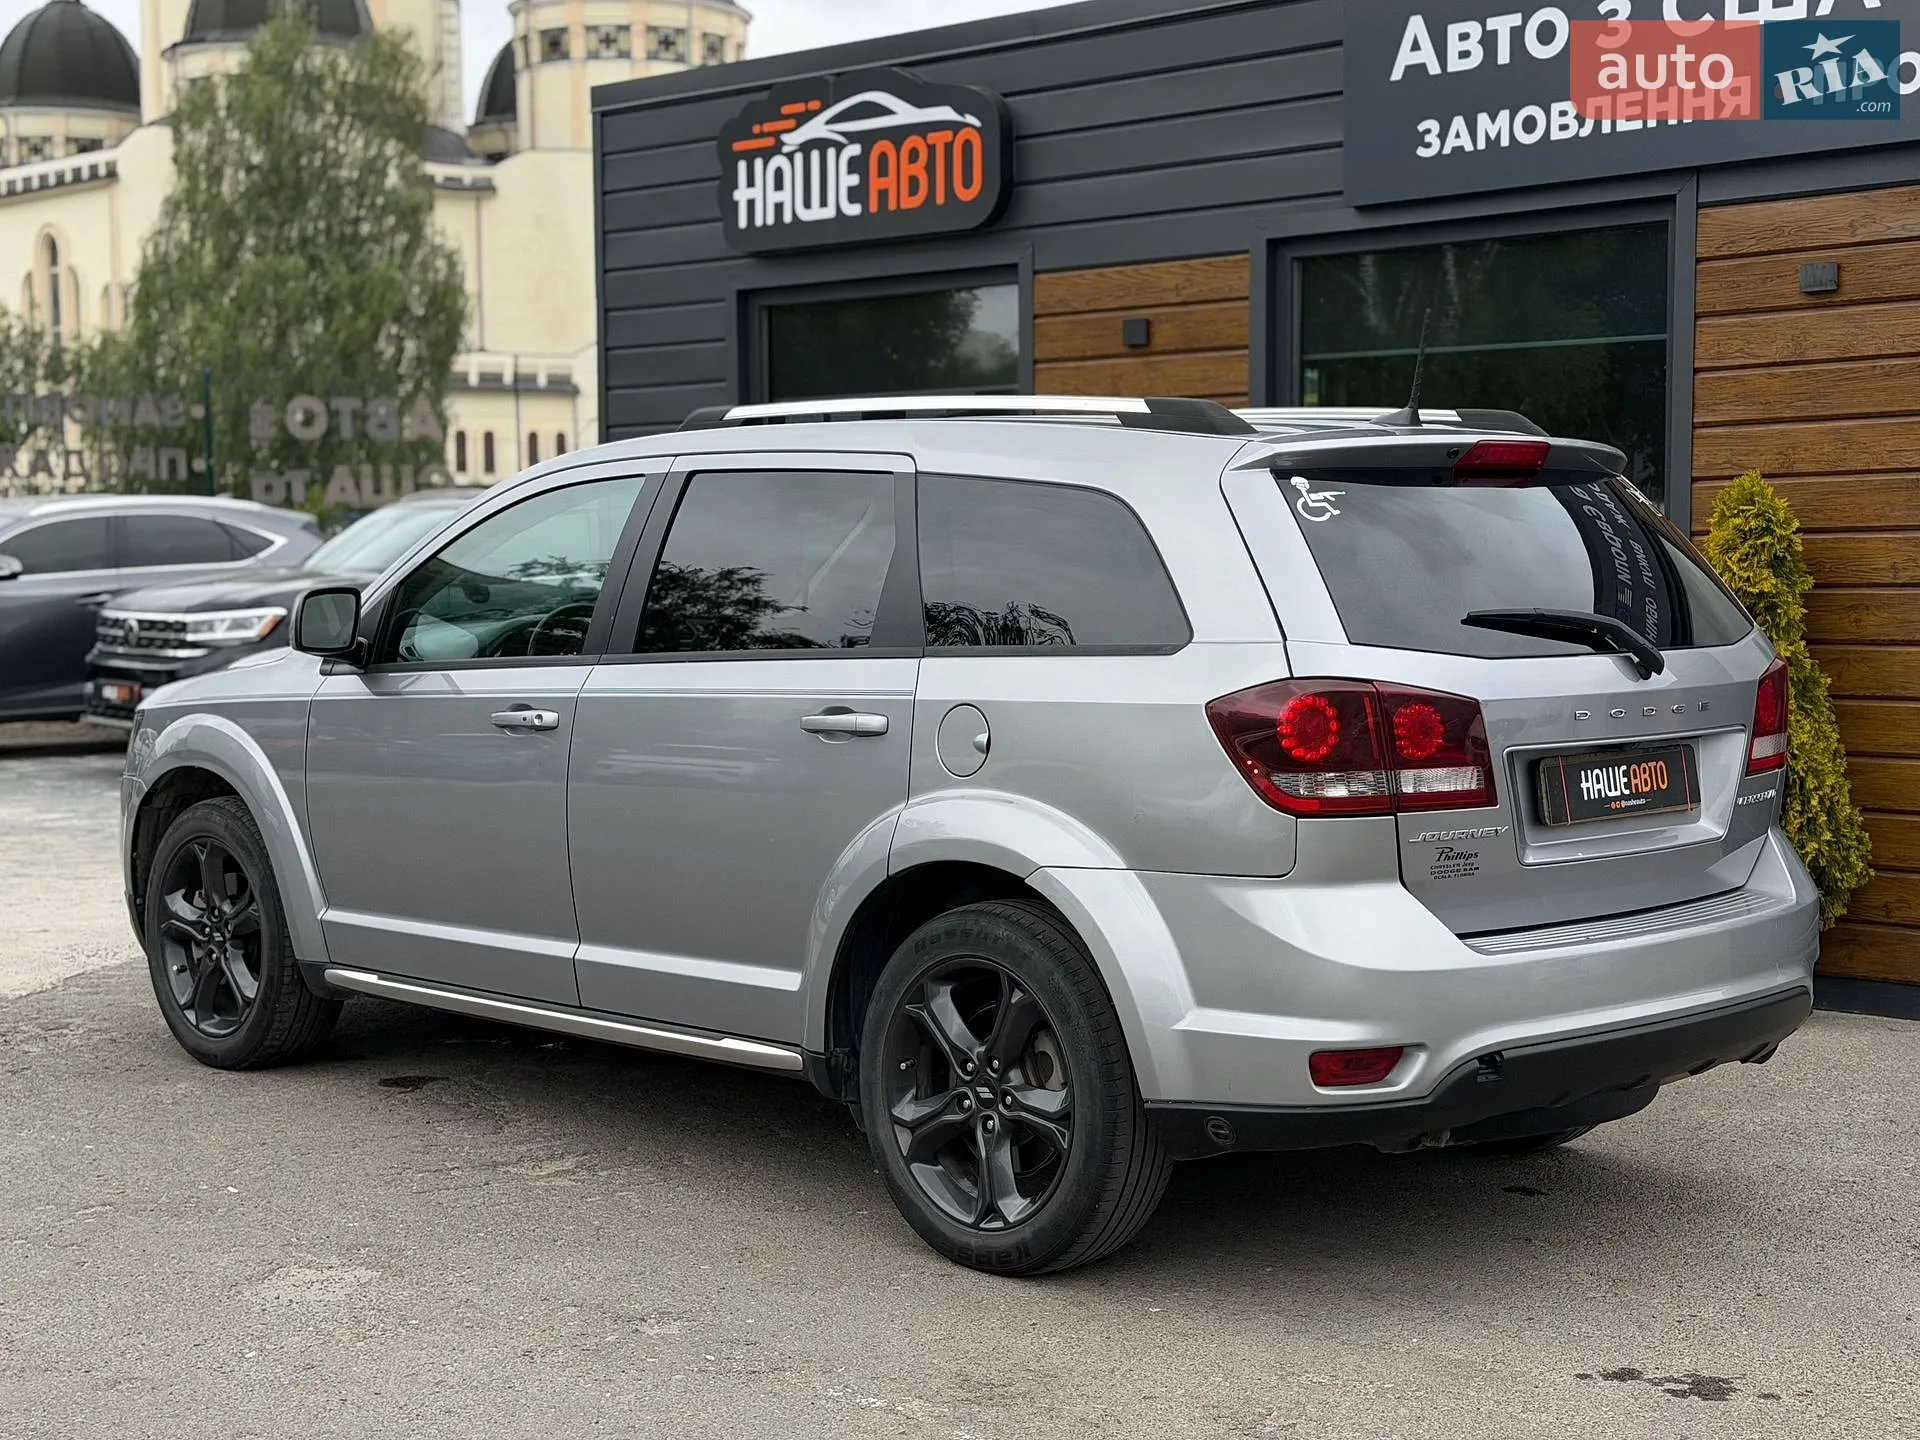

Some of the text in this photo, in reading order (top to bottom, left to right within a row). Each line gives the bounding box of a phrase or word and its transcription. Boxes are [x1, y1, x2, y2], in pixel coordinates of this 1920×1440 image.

[1390, 6, 1570, 82] Авто
[1416, 75, 1752, 158] ЗАМОВЛЕННЯ
[732, 126, 983, 230] НАШЕ АВТО
[1574, 701, 1711, 721] DODGE
[1580, 760, 1668, 800] НАШЕ АВТО
[1408, 825, 1509, 843] JOURNEY
[1434, 846, 1480, 862] Phillips
[1430, 868, 1462, 876] DODGE
